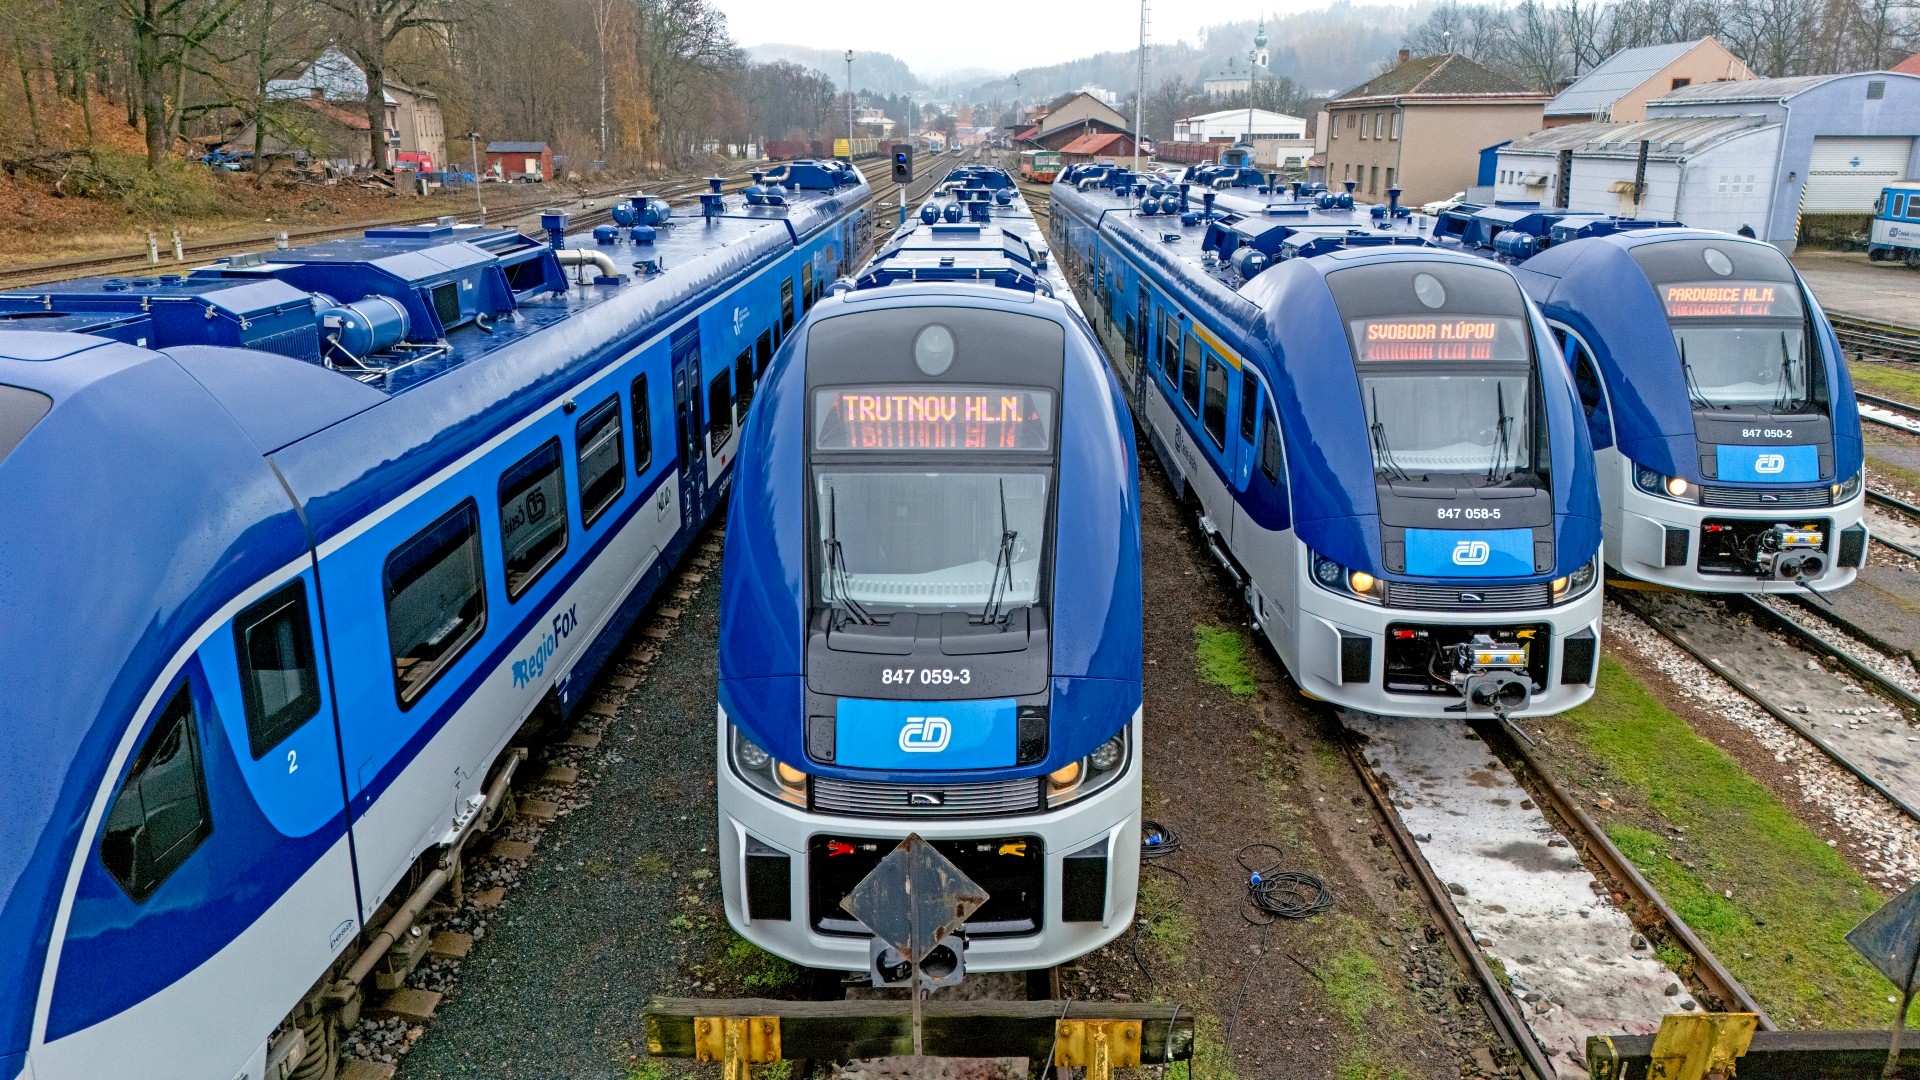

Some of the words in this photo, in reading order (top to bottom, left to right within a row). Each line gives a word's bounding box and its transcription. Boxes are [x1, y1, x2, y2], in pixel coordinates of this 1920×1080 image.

[1668, 287, 1740, 302] PARDUBICE
[1742, 287, 1775, 302] HL.N.
[1368, 323, 1437, 340] SVOBODA
[1440, 321, 1495, 339] N.ÚPOU
[842, 395, 956, 422] TRUTNOV
[965, 396, 1022, 422] HL.N.
[1742, 429, 1761, 438] 847
[1764, 429, 1793, 438] 050-2
[1437, 508, 1461, 519] 847
[1465, 508, 1501, 519] 058-5
[513, 603, 577, 690] RegioFox
[882, 669, 915, 684] 847
[920, 669, 971, 684] 059-3
[287, 749, 298, 775] 2
